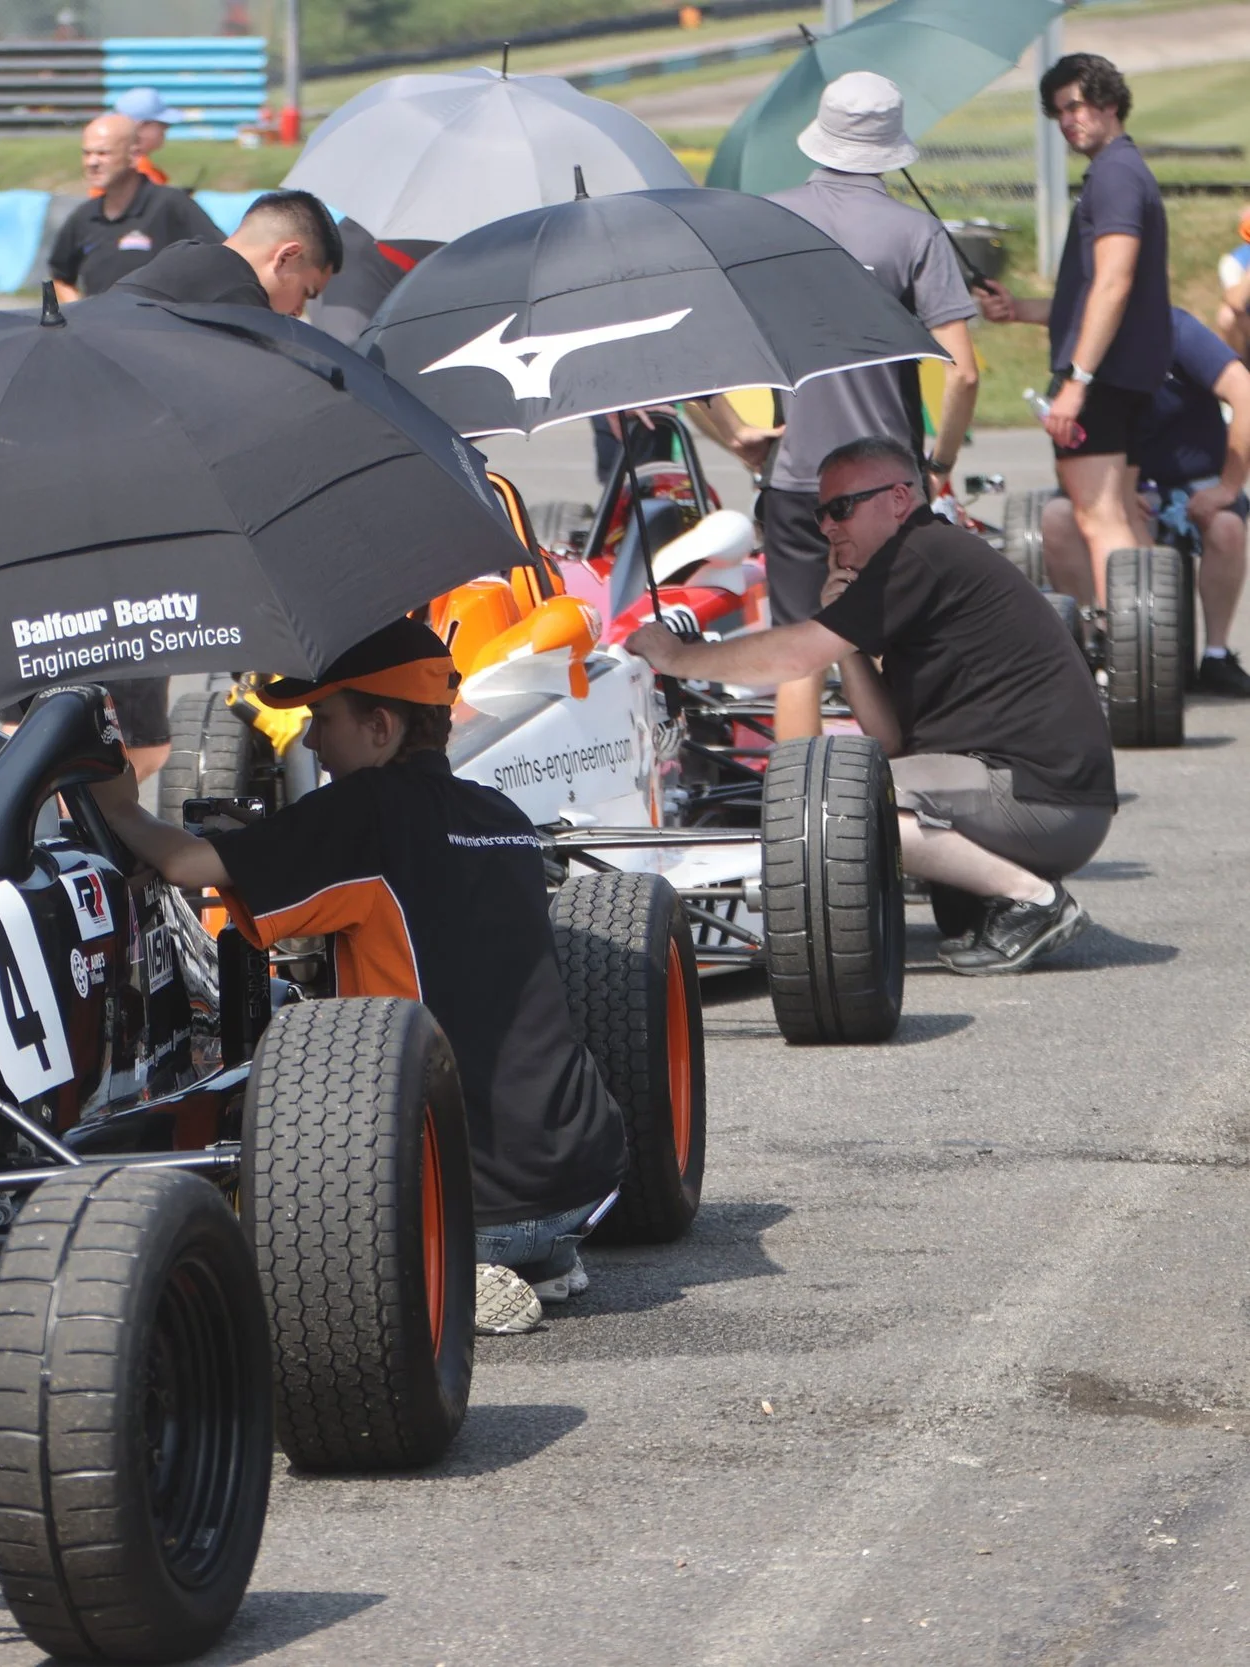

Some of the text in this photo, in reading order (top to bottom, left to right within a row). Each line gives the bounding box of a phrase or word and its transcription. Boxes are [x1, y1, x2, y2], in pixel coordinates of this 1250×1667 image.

[12, 593, 198, 648] Balfour Beatty
[18, 624, 241, 679] Engineering Services
[494, 737, 632, 791] smiths-engineering.com
[247, 951, 263, 1019] DKINS
